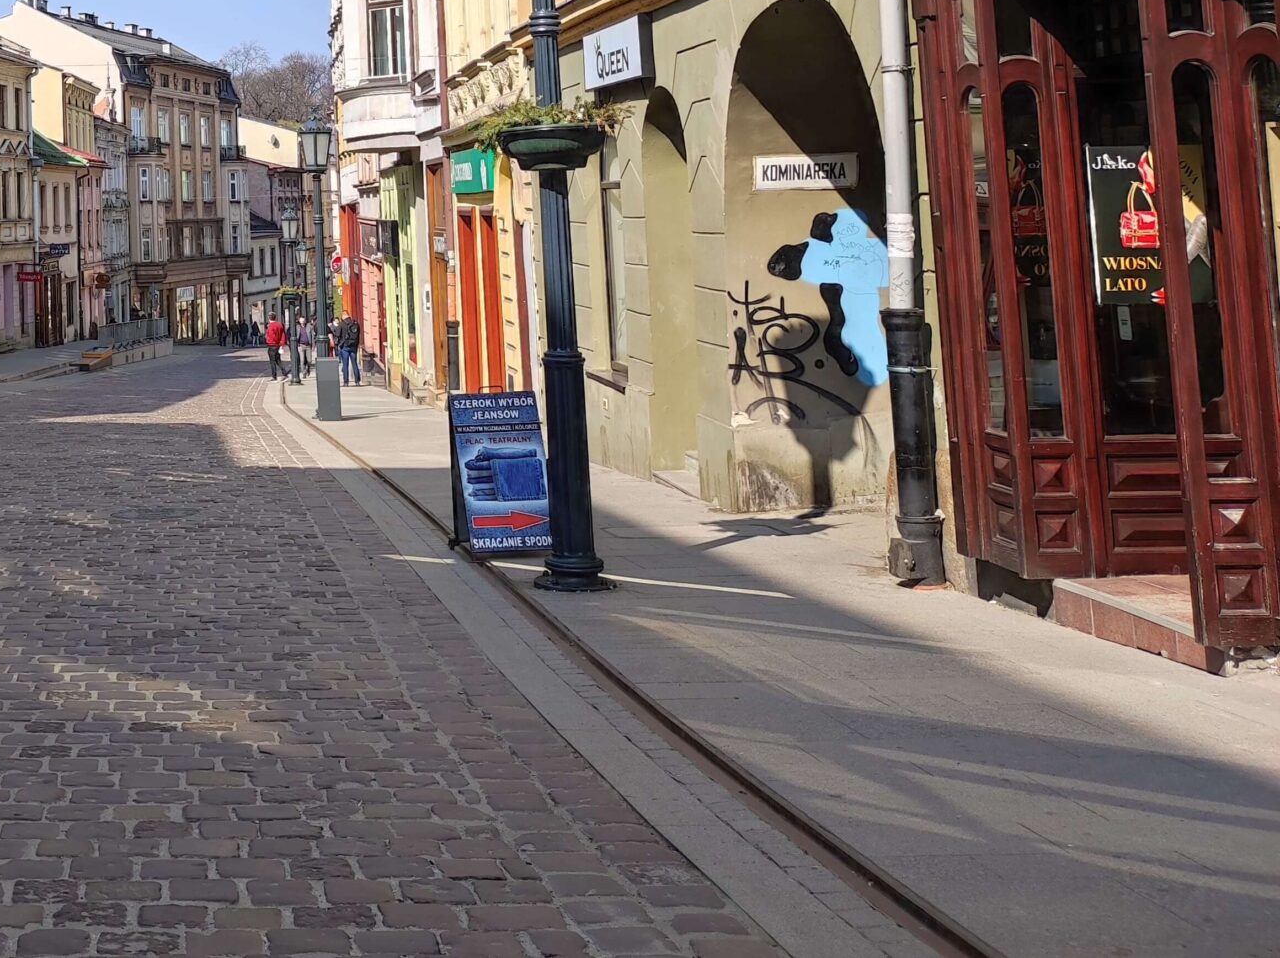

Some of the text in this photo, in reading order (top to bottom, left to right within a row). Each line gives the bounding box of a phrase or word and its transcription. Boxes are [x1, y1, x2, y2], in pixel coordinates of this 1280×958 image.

[762, 162, 847, 181] KOMINIARSKA
[1105, 277, 1147, 292] LATO
[454, 396, 534, 409] SZEROKI WYBÓR
[472, 409, 519, 420] JEANSÓW
[465, 436, 532, 445] PLAC TEATRALNY
[473, 536, 523, 548] SKRACANIE
